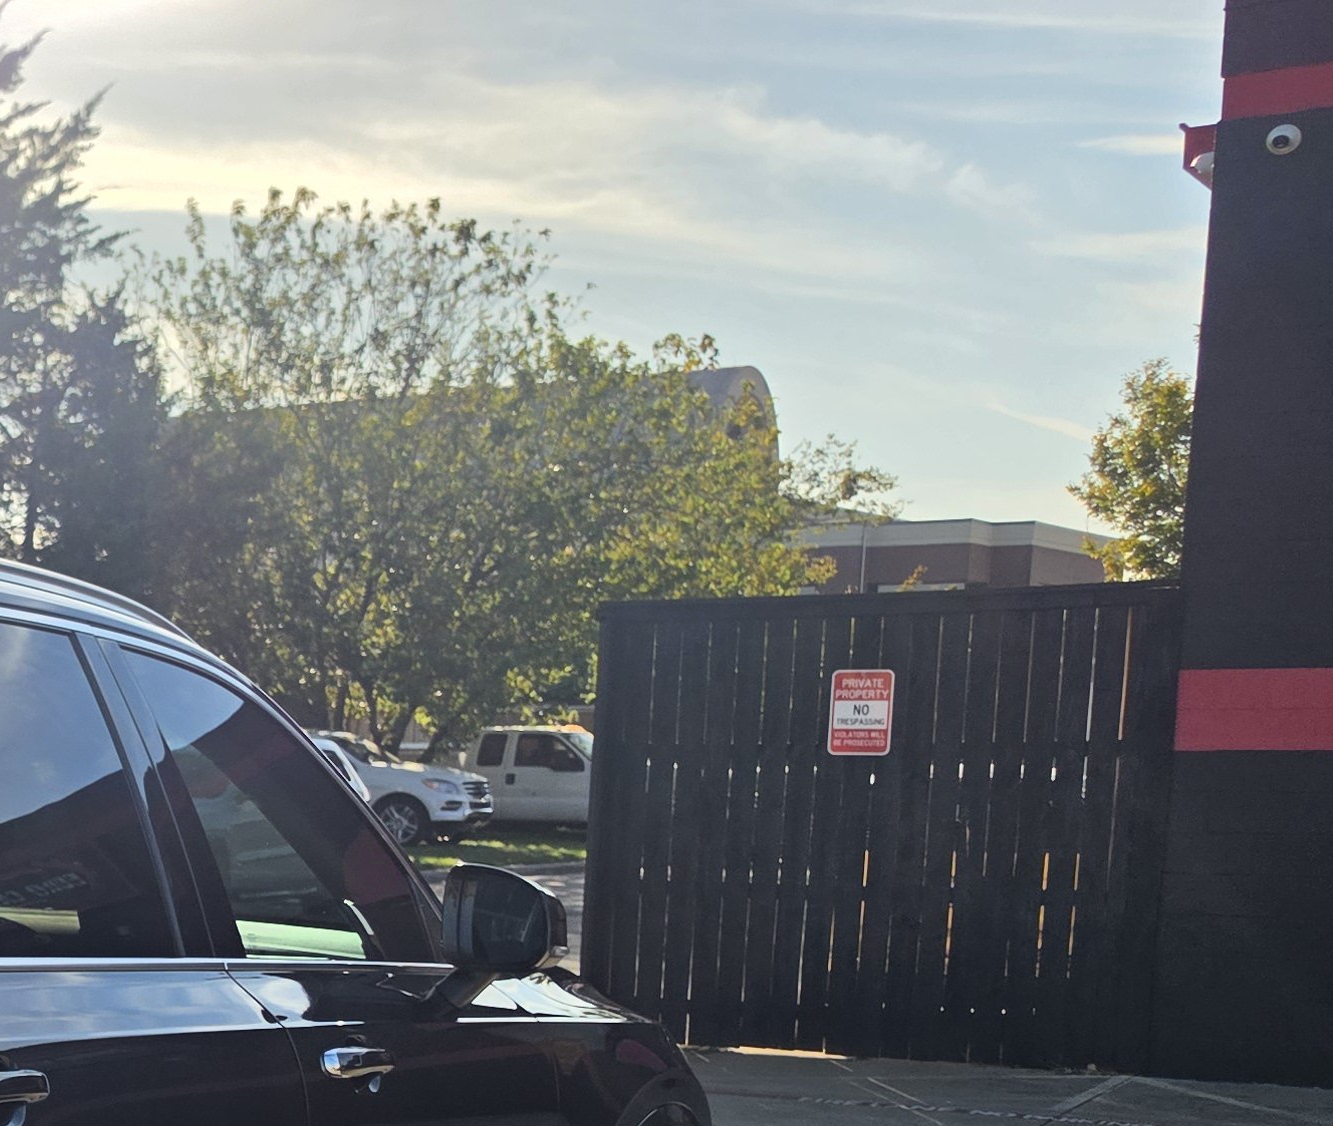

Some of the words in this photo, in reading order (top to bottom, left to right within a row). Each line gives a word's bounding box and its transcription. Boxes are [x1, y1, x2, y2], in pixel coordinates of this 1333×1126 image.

[842, 678, 884, 688] PRIVATE
[835, 690, 889, 699] PROPERTY
[852, 704, 870, 716] NO
[836, 718, 885, 726] TRESPASSING
